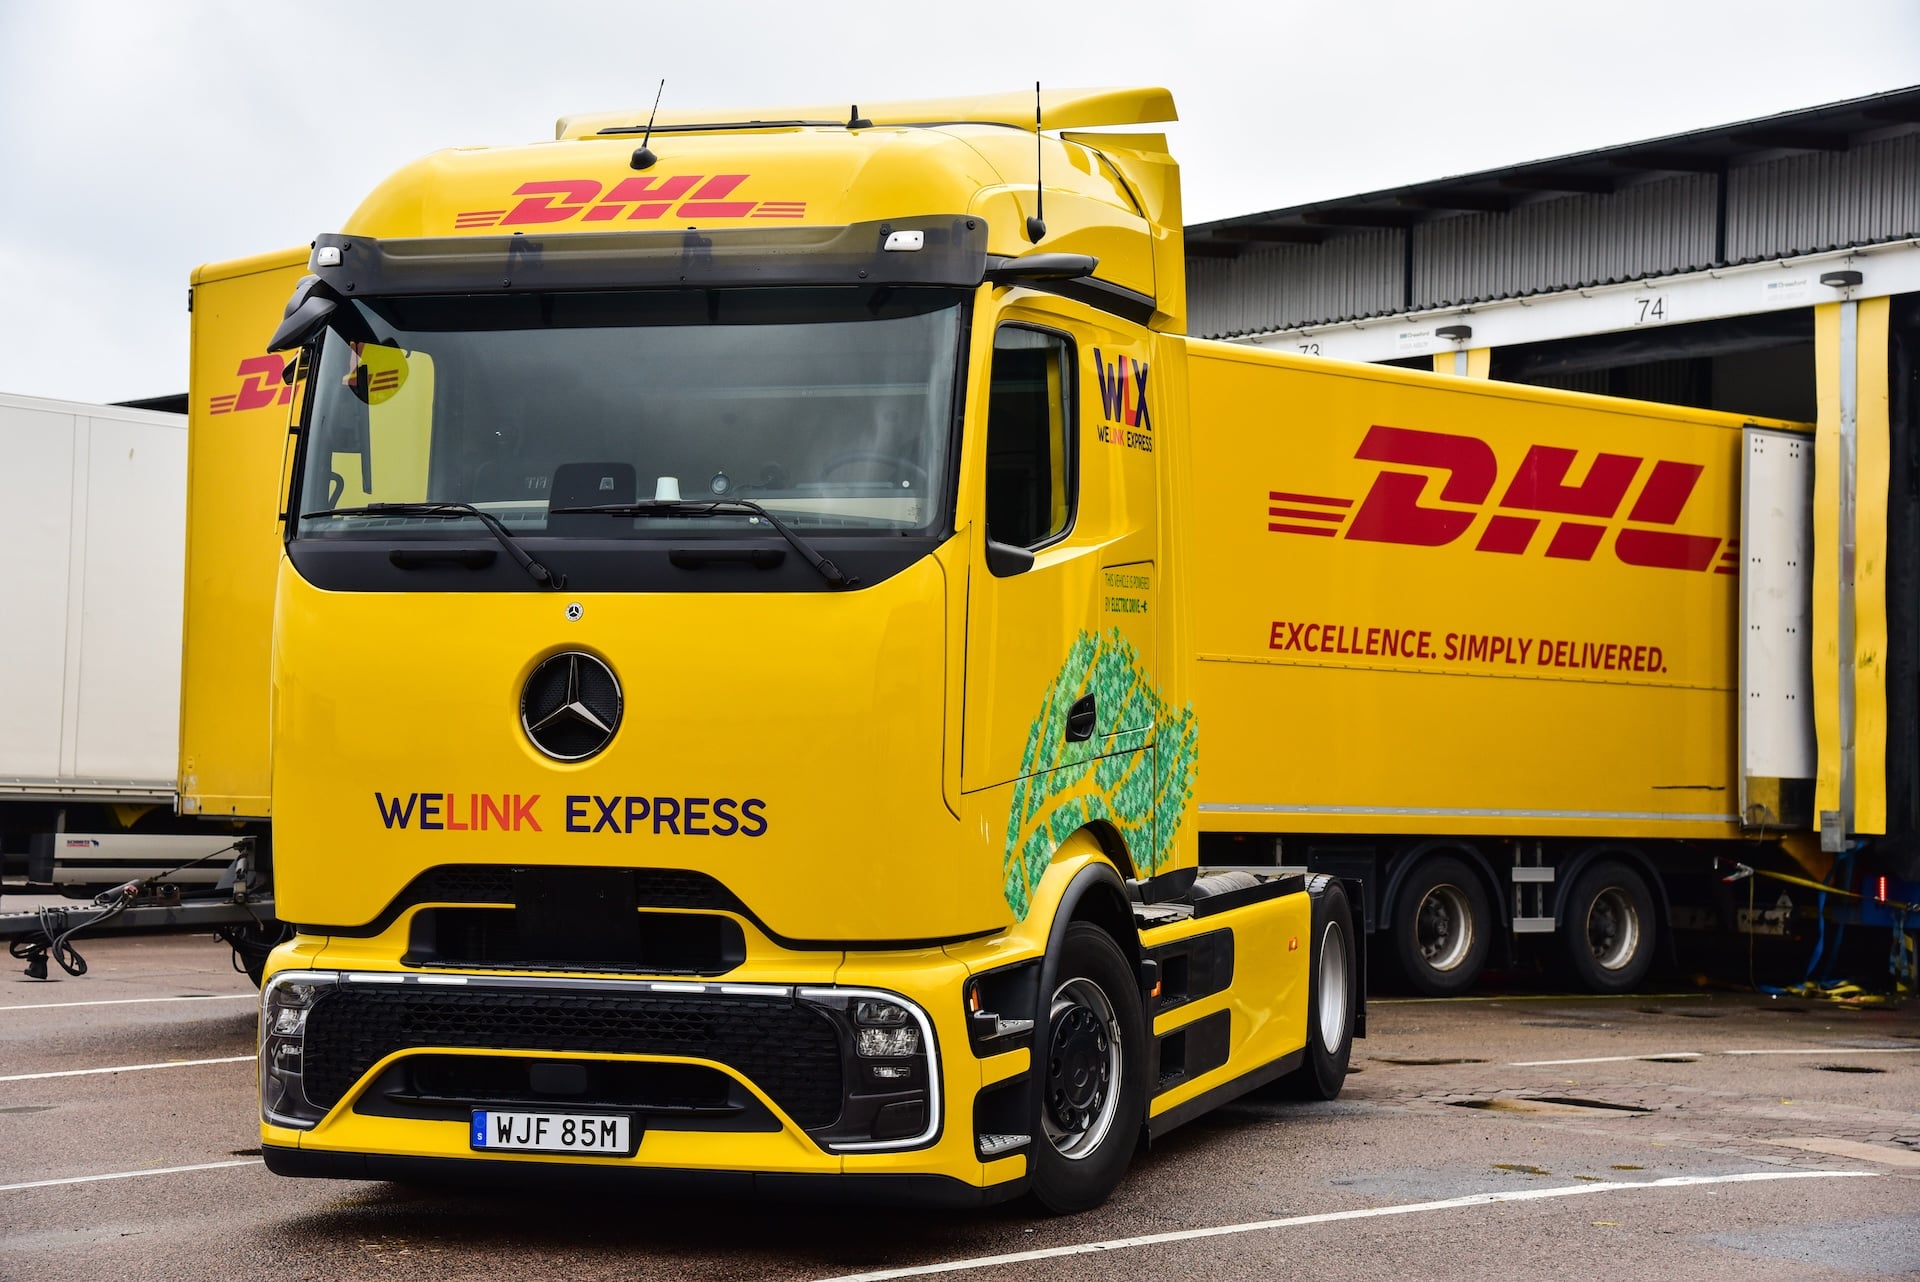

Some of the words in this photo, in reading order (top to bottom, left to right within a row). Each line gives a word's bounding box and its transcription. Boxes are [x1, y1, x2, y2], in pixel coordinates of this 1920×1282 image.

[498, 174, 759, 225] DHL
[1637, 297, 1664, 322] 74
[1093, 347, 1152, 431] WLX
[1097, 424, 1124, 446] WELINK
[1127, 431, 1152, 453] EXPRESS
[1344, 425, 1722, 572] DHL
[1112, 597, 1129, 613] ELECTRIC
[1129, 598, 1140, 613] DRIVE
[1269, 621, 1437, 660] EXCELLENCE.
[1444, 632, 1533, 665] SIMPLY
[1537, 639, 1668, 674] DELIVERED.
[375, 792, 542, 832] WELINK
[566, 795, 768, 837] EXPRESS
[477, 1132, 483, 1141] S
[496, 1116, 550, 1145] WJF
[561, 1119, 617, 1148] 85M
